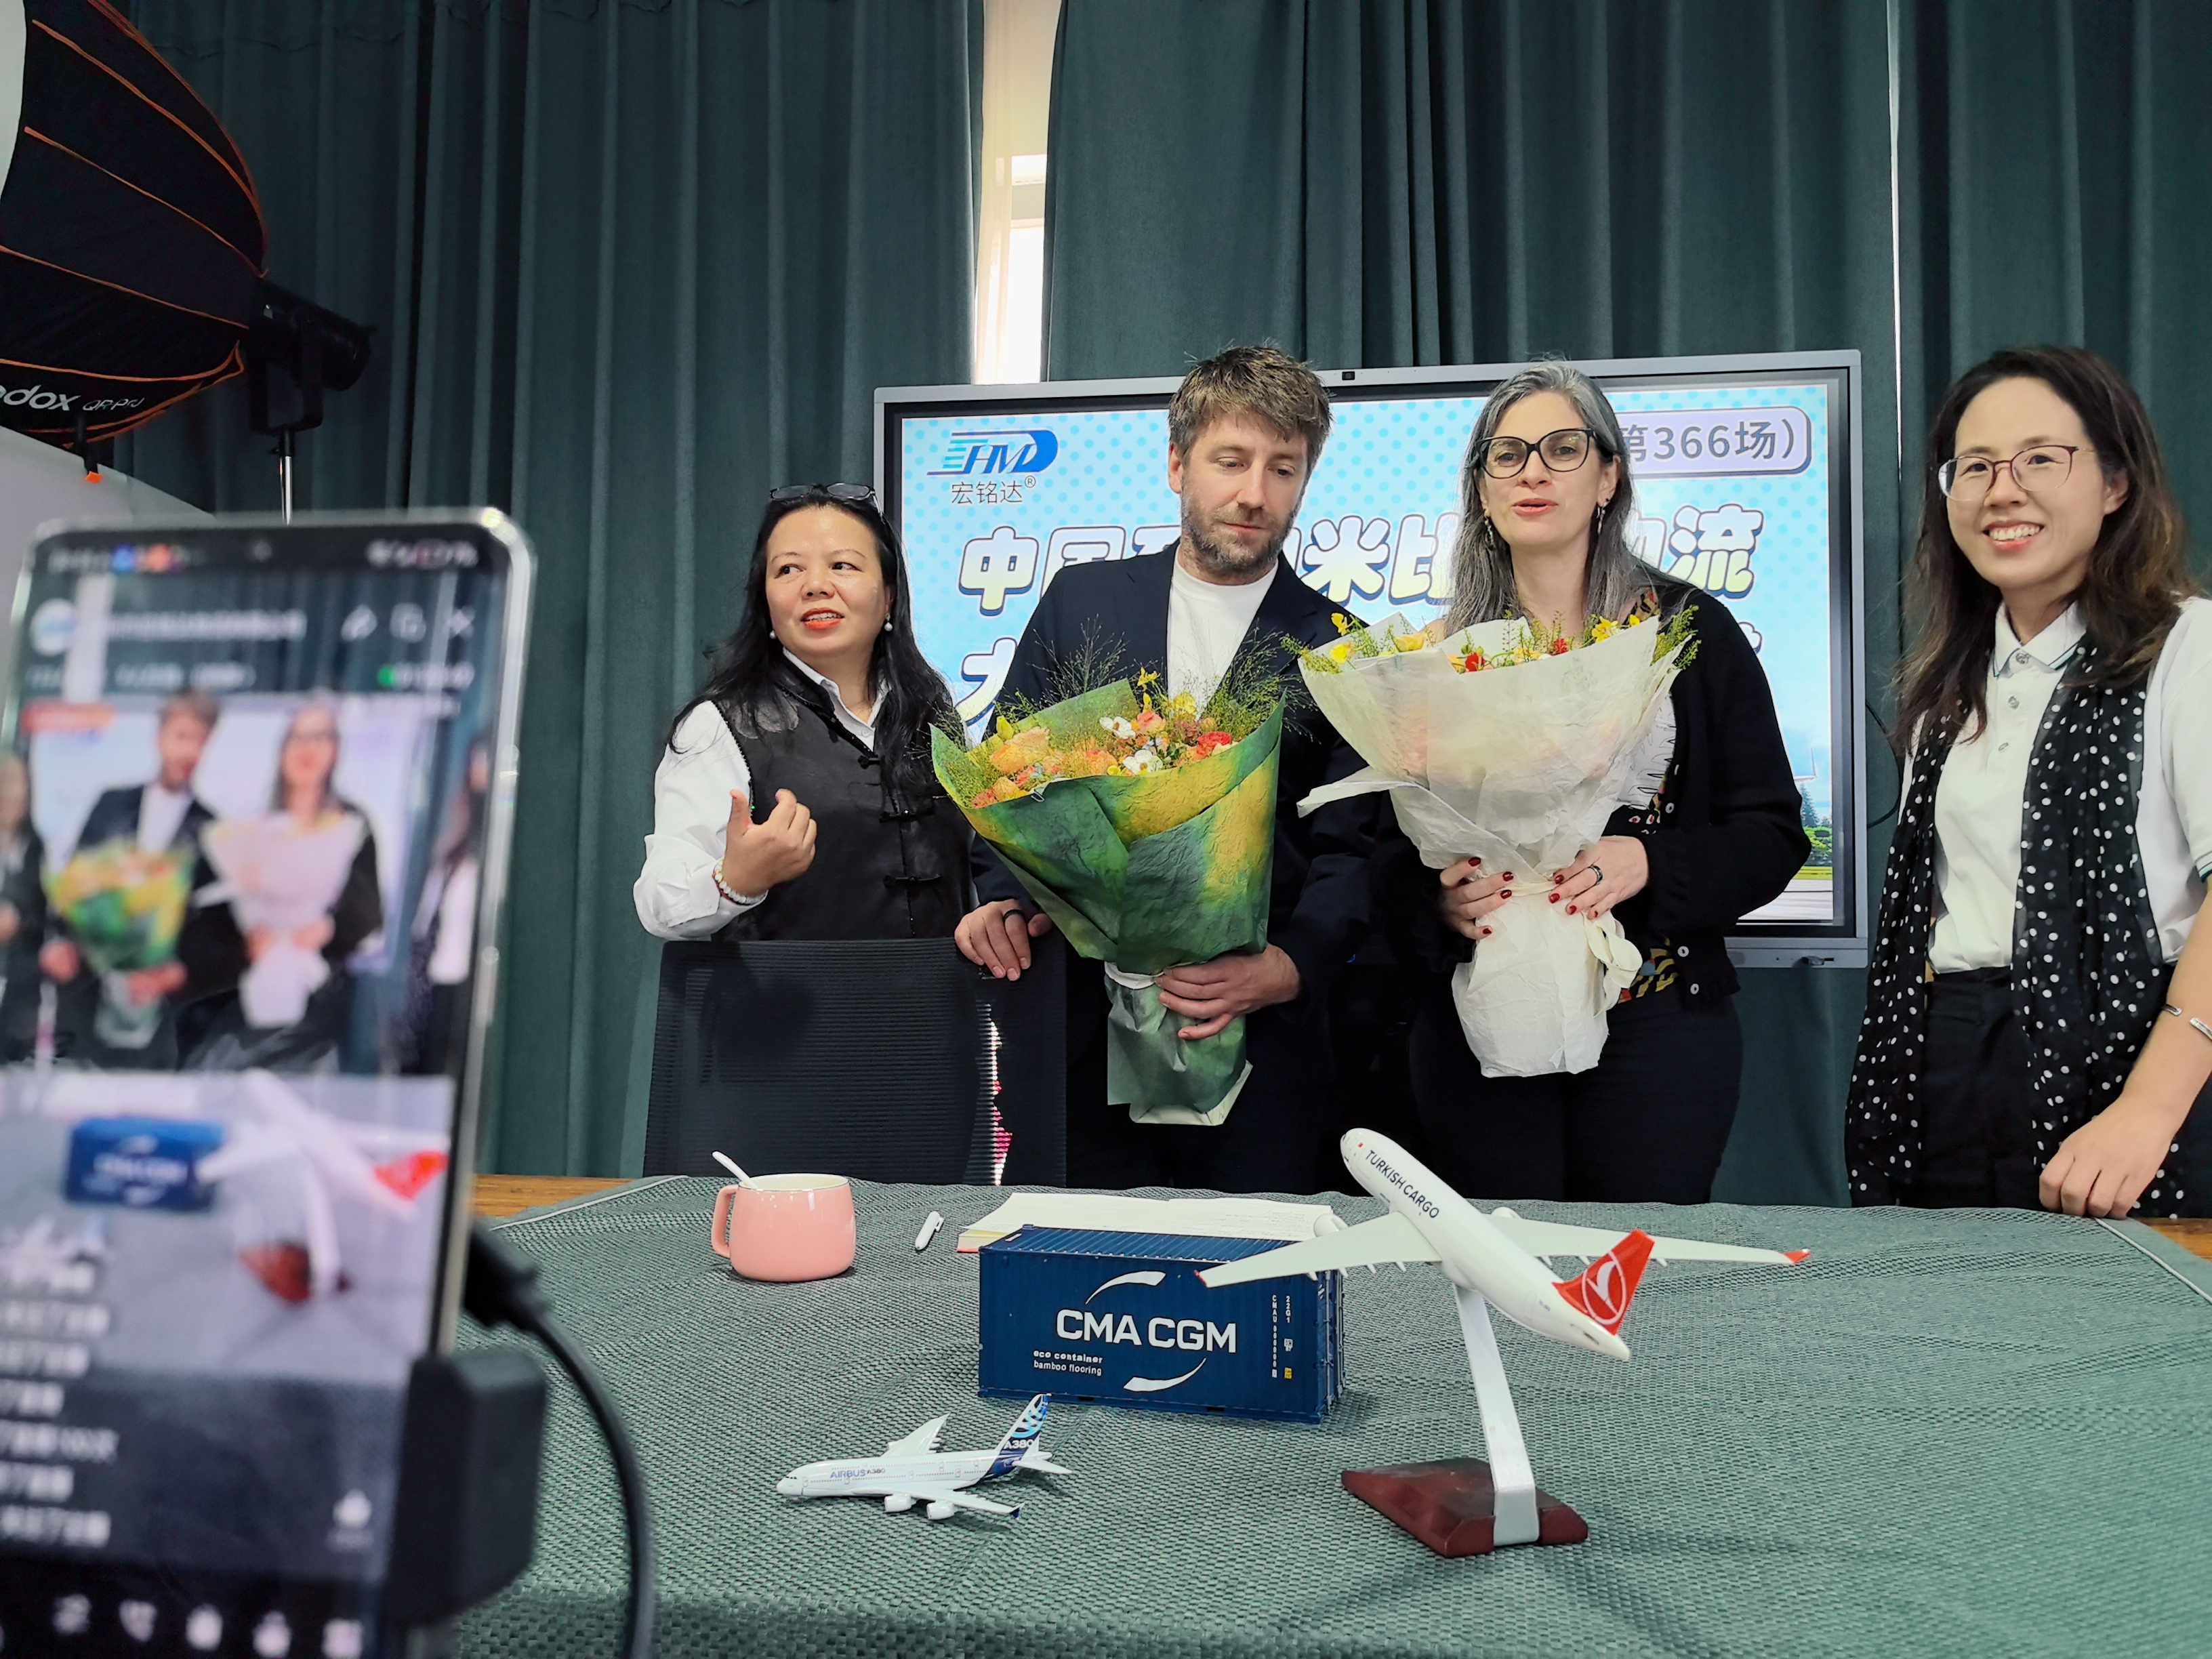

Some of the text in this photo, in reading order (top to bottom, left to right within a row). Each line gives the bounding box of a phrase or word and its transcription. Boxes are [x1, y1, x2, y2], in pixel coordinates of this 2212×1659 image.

[0, 384, 81, 411] dox
[1365, 1149, 1439, 1218] TURKISH CARGO
[1057, 1309, 1236, 1353] CMA CGM
[1033, 1350, 1103, 1364] eco container
[1033, 1359, 1102, 1376] bamboo flooring
[1003, 1439, 1035, 1450] A380
[830, 1469, 866, 1478] AIRBUS
